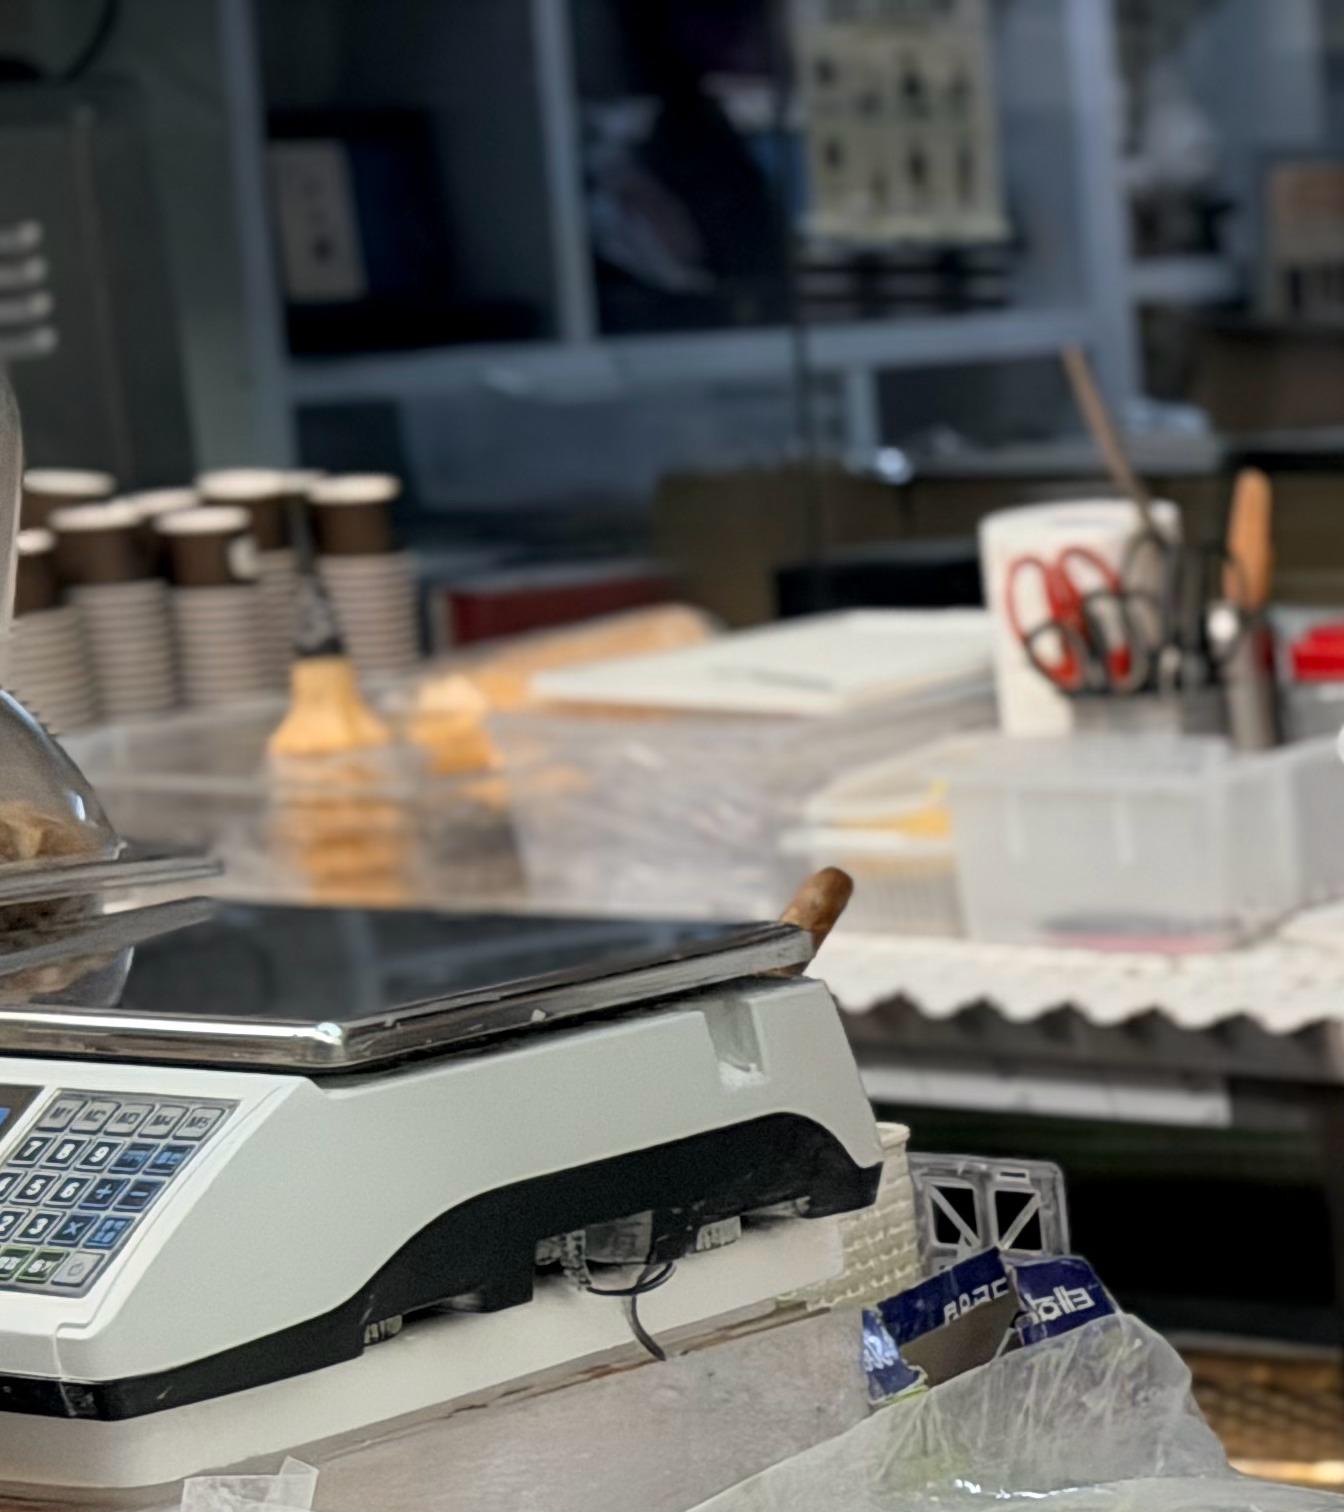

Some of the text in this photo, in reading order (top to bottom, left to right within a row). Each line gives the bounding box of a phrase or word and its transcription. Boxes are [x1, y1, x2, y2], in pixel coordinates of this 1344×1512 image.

[22, 1139, 44, 1158] 7
[58, 1142, 76, 1161] 8
[88, 1145, 110, 1164] 9
[25, 1178, 47, 1197] 5
[59, 1181, 81, 1199] 6
[27, 1217, 49, 1236] 3
